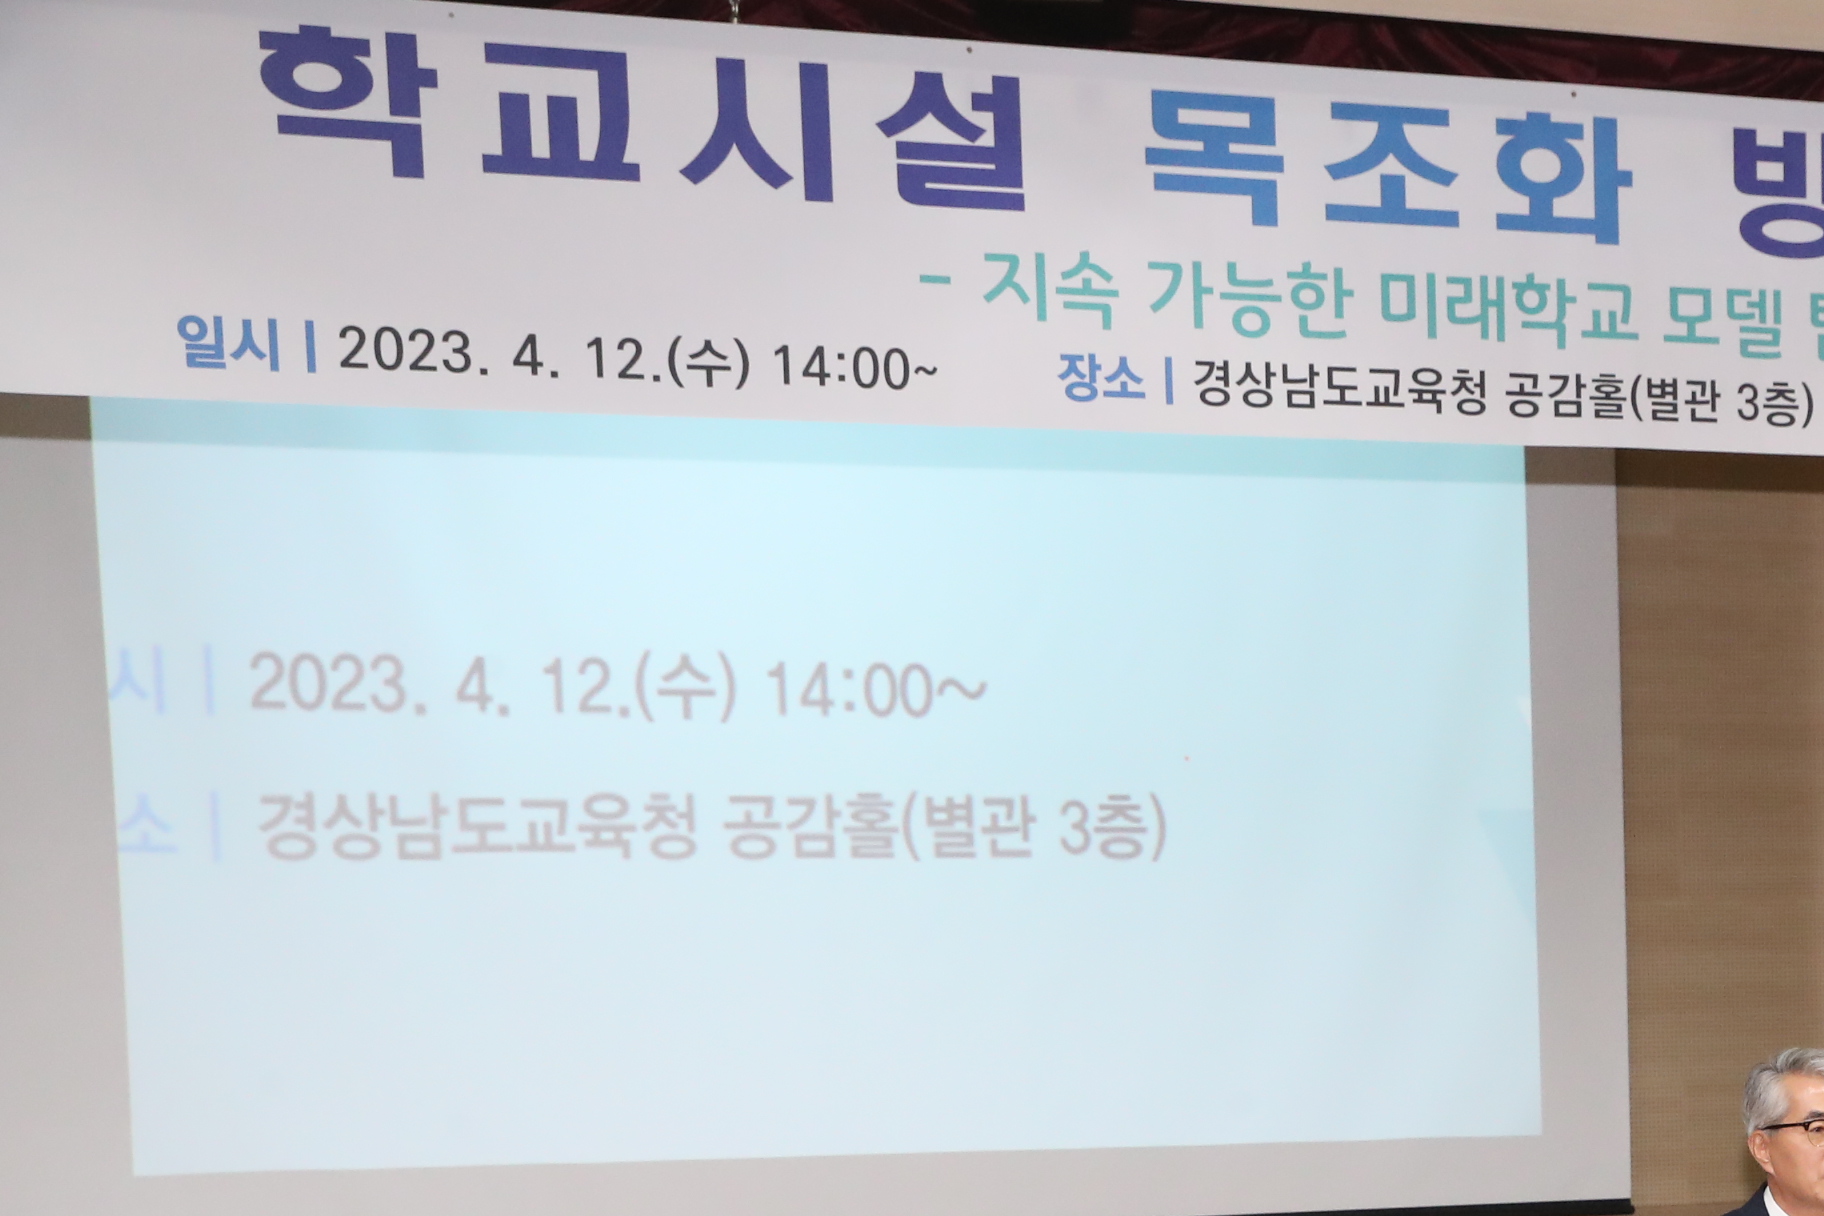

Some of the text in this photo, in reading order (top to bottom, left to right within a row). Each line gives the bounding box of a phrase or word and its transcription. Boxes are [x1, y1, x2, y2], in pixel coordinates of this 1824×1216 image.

[258, 24, 1026, 212] 학교시설
[1145, 89, 1634, 246] 목조화
[983, 251, 1119, 330] 지속
[1148, 261, 1354, 339] 가능한
[1381, 272, 1639, 349] 미래학교
[1664, 287, 1781, 359] 모델
[177, 315, 279, 372] 일시
[339, 325, 488, 376] 2023.
[513, 333, 559, 378] 4.
[587, 335, 749, 390] 12.(수)
[774, 344, 938, 390] 14:00~
[1057, 353, 1146, 402] 장소
[1194, 360, 1486, 416] 경상남도교육청
[1505, 372, 1721, 423] 공감홀(별관
[1737, 381, 1814, 429] 3층)
[249, 650, 427, 716] 2023.
[456, 656, 509, 717] 4.
[543, 650, 737, 724] 12.(수)
[767, 661, 988, 719] 14:00~
[258, 790, 697, 862] 경상남도교육청
[723, 791, 1037, 862] 공감홀(별관
[1060, 792, 1167, 862] 3층)
